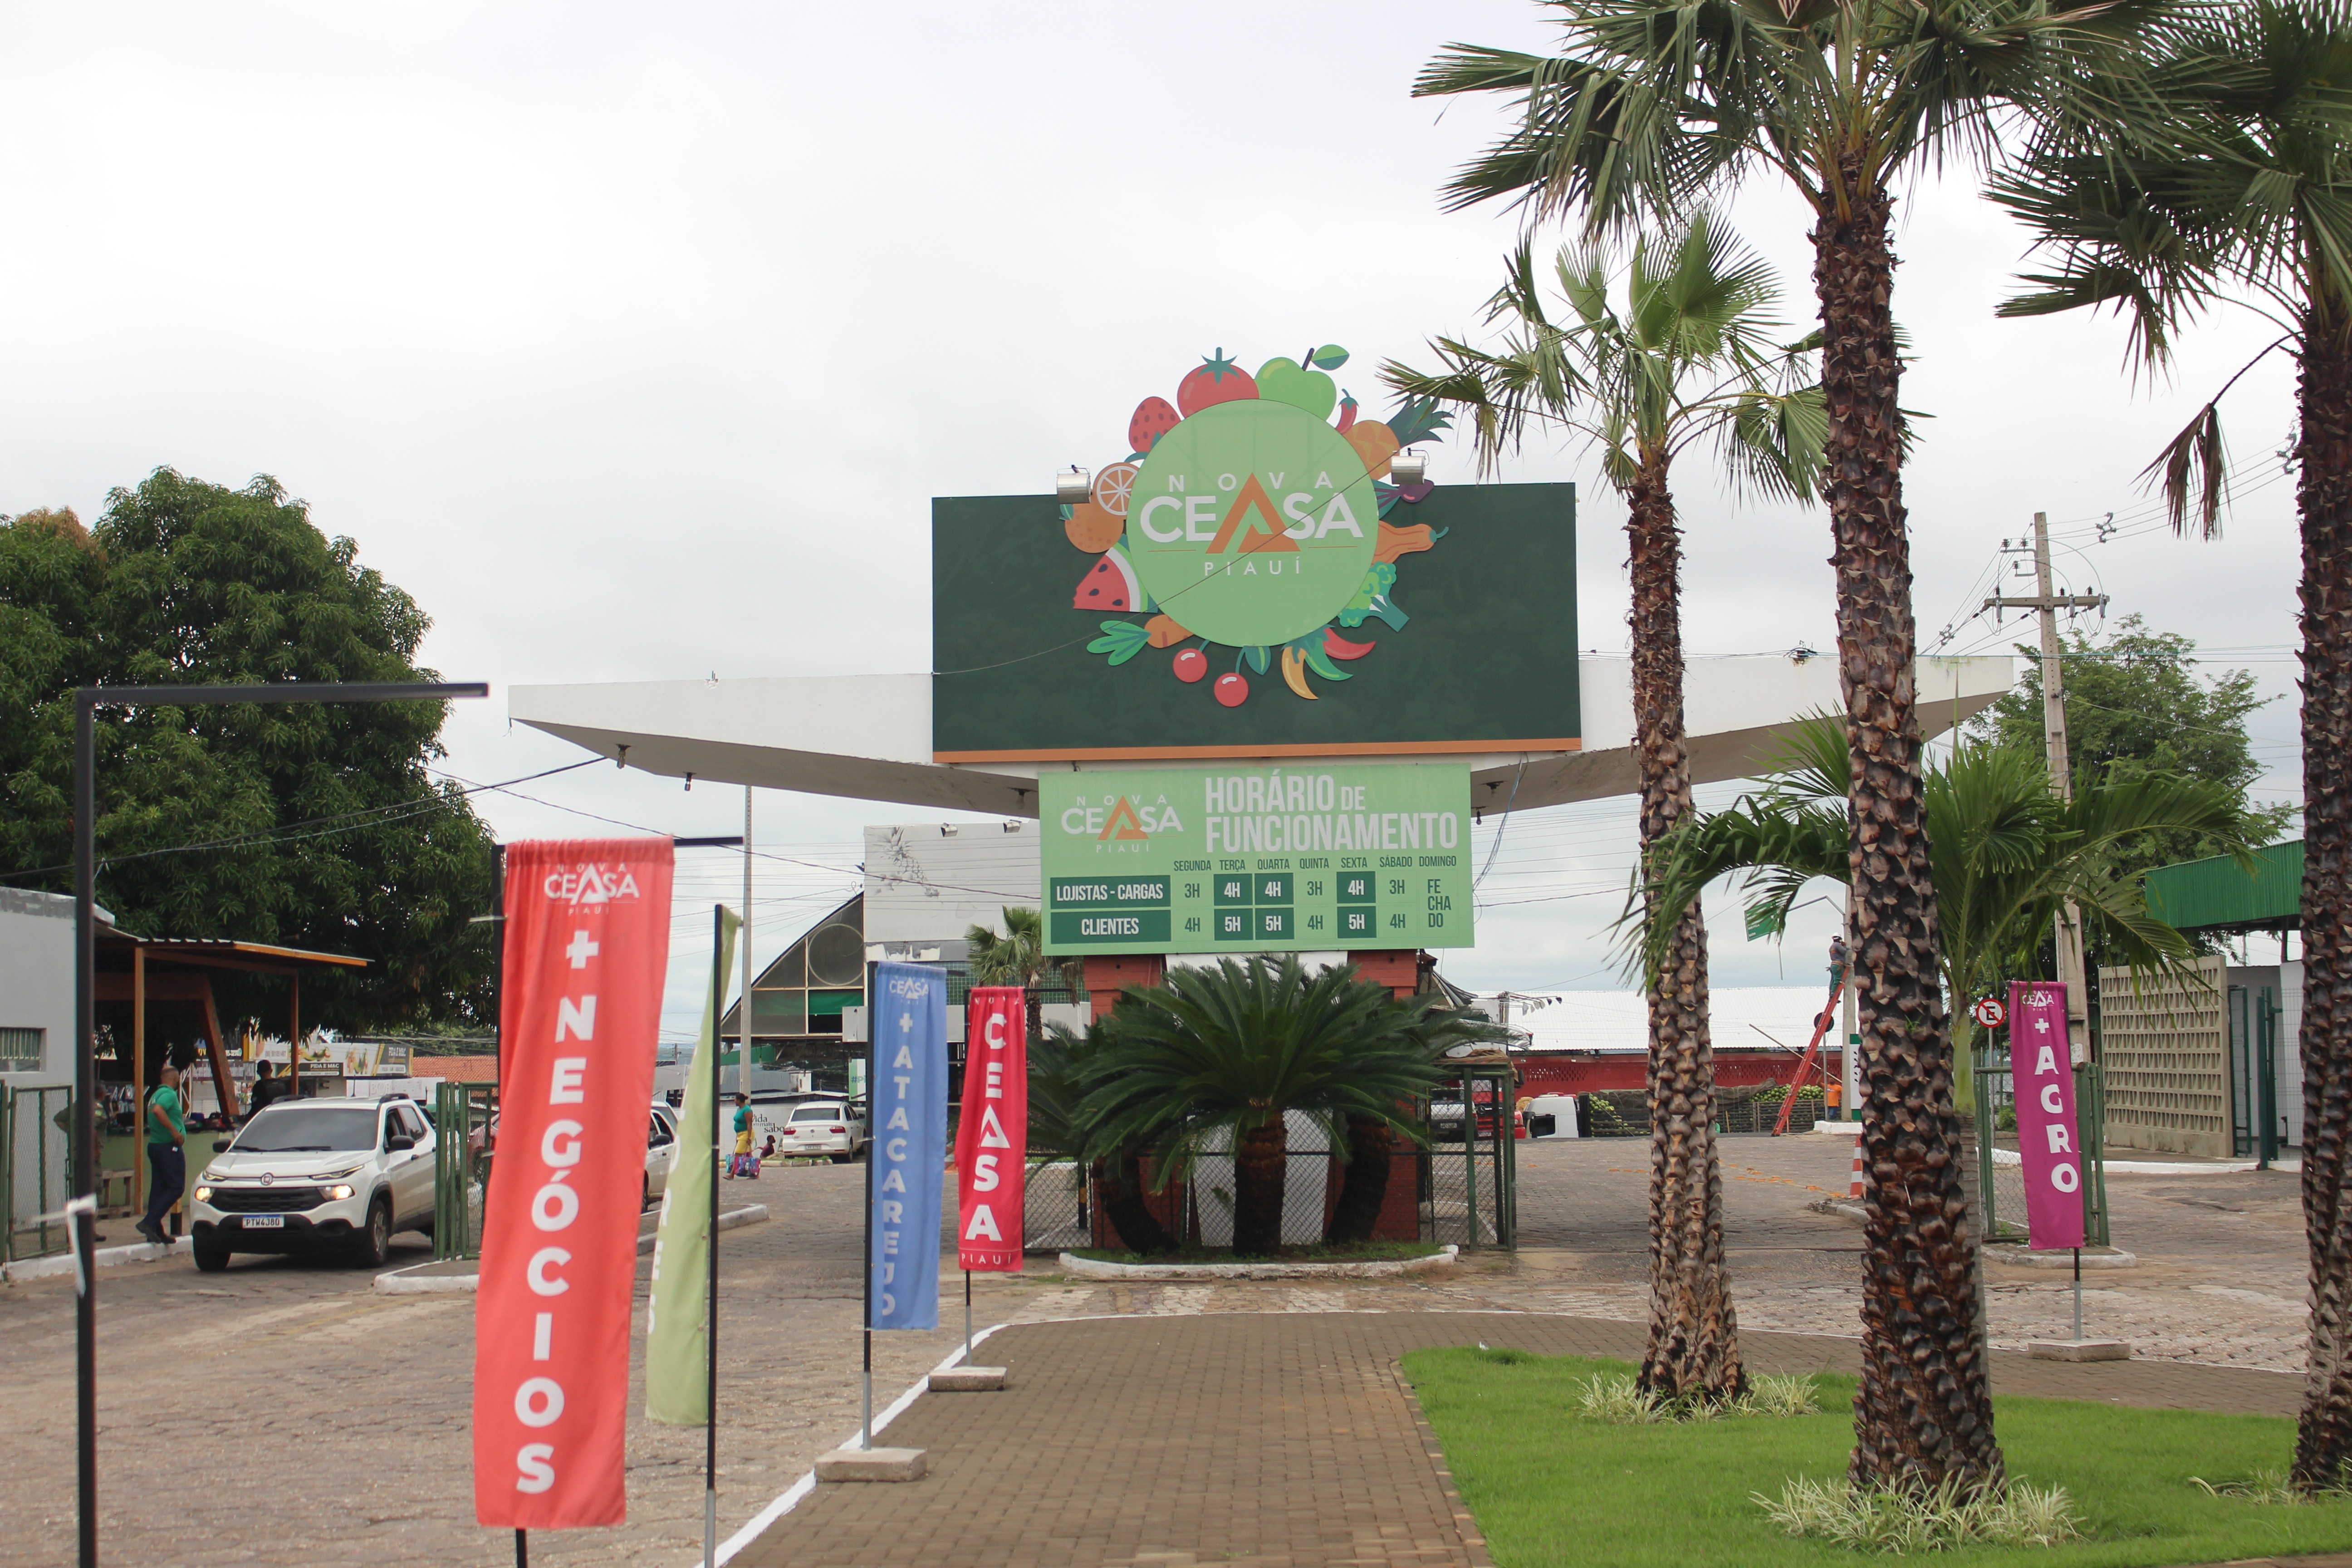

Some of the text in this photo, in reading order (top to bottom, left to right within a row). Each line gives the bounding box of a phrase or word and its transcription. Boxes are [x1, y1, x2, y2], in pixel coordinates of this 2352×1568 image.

[1169, 471, 1333, 492] NOVA
[1140, 472, 1364, 554] CEASA
[1204, 557, 1301, 576] PIAUÍ
[1077, 794, 1167, 806] NOVA
[1205, 769, 1365, 813] HORÁRIO DE
[1061, 795, 1184, 840] CEASA
[1206, 812, 1457, 853] FUNCIONAMENTO
[1096, 842, 1149, 853] PIAUÍ
[557, 862, 626, 873] NOVA
[1174, 855, 1456, 872] SEGUNDA TERÇA QUARTA QUINTA SEXTA SÁBADO DOMINGO
[544, 863, 640, 905] CEASA
[1056, 885, 1107, 901] LOJISTAS
[1117, 884, 1163, 900] CARGAS
[1185, 883, 1200, 898] 3H
[1224, 882, 1240, 897] 4H
[1265, 882, 1281, 897] 4H
[1307, 881, 1323, 896] 3H
[1348, 880, 1364, 895] 4H
[1390, 879, 1405, 894] 3H
[1428, 879, 1441, 893] FE
[1428, 896, 1451, 911] CHA
[1081, 914, 1406, 935] CLIENTES 4H 5H 5H 4H 5H 4H
[1428, 913, 1443, 927] DO
[889, 977, 929, 1000] CEASA
[764, 1123, 784, 1133] sabo
[965, 1012, 1010, 1242] CEASA
[2034, 1045, 2078, 1193] AGRO
[882, 1046, 913, 1316] ATACAREJO
[514, 995, 597, 1494] NEGÓCIOS
[961, 1253, 1011, 1264] PIAUÍ
